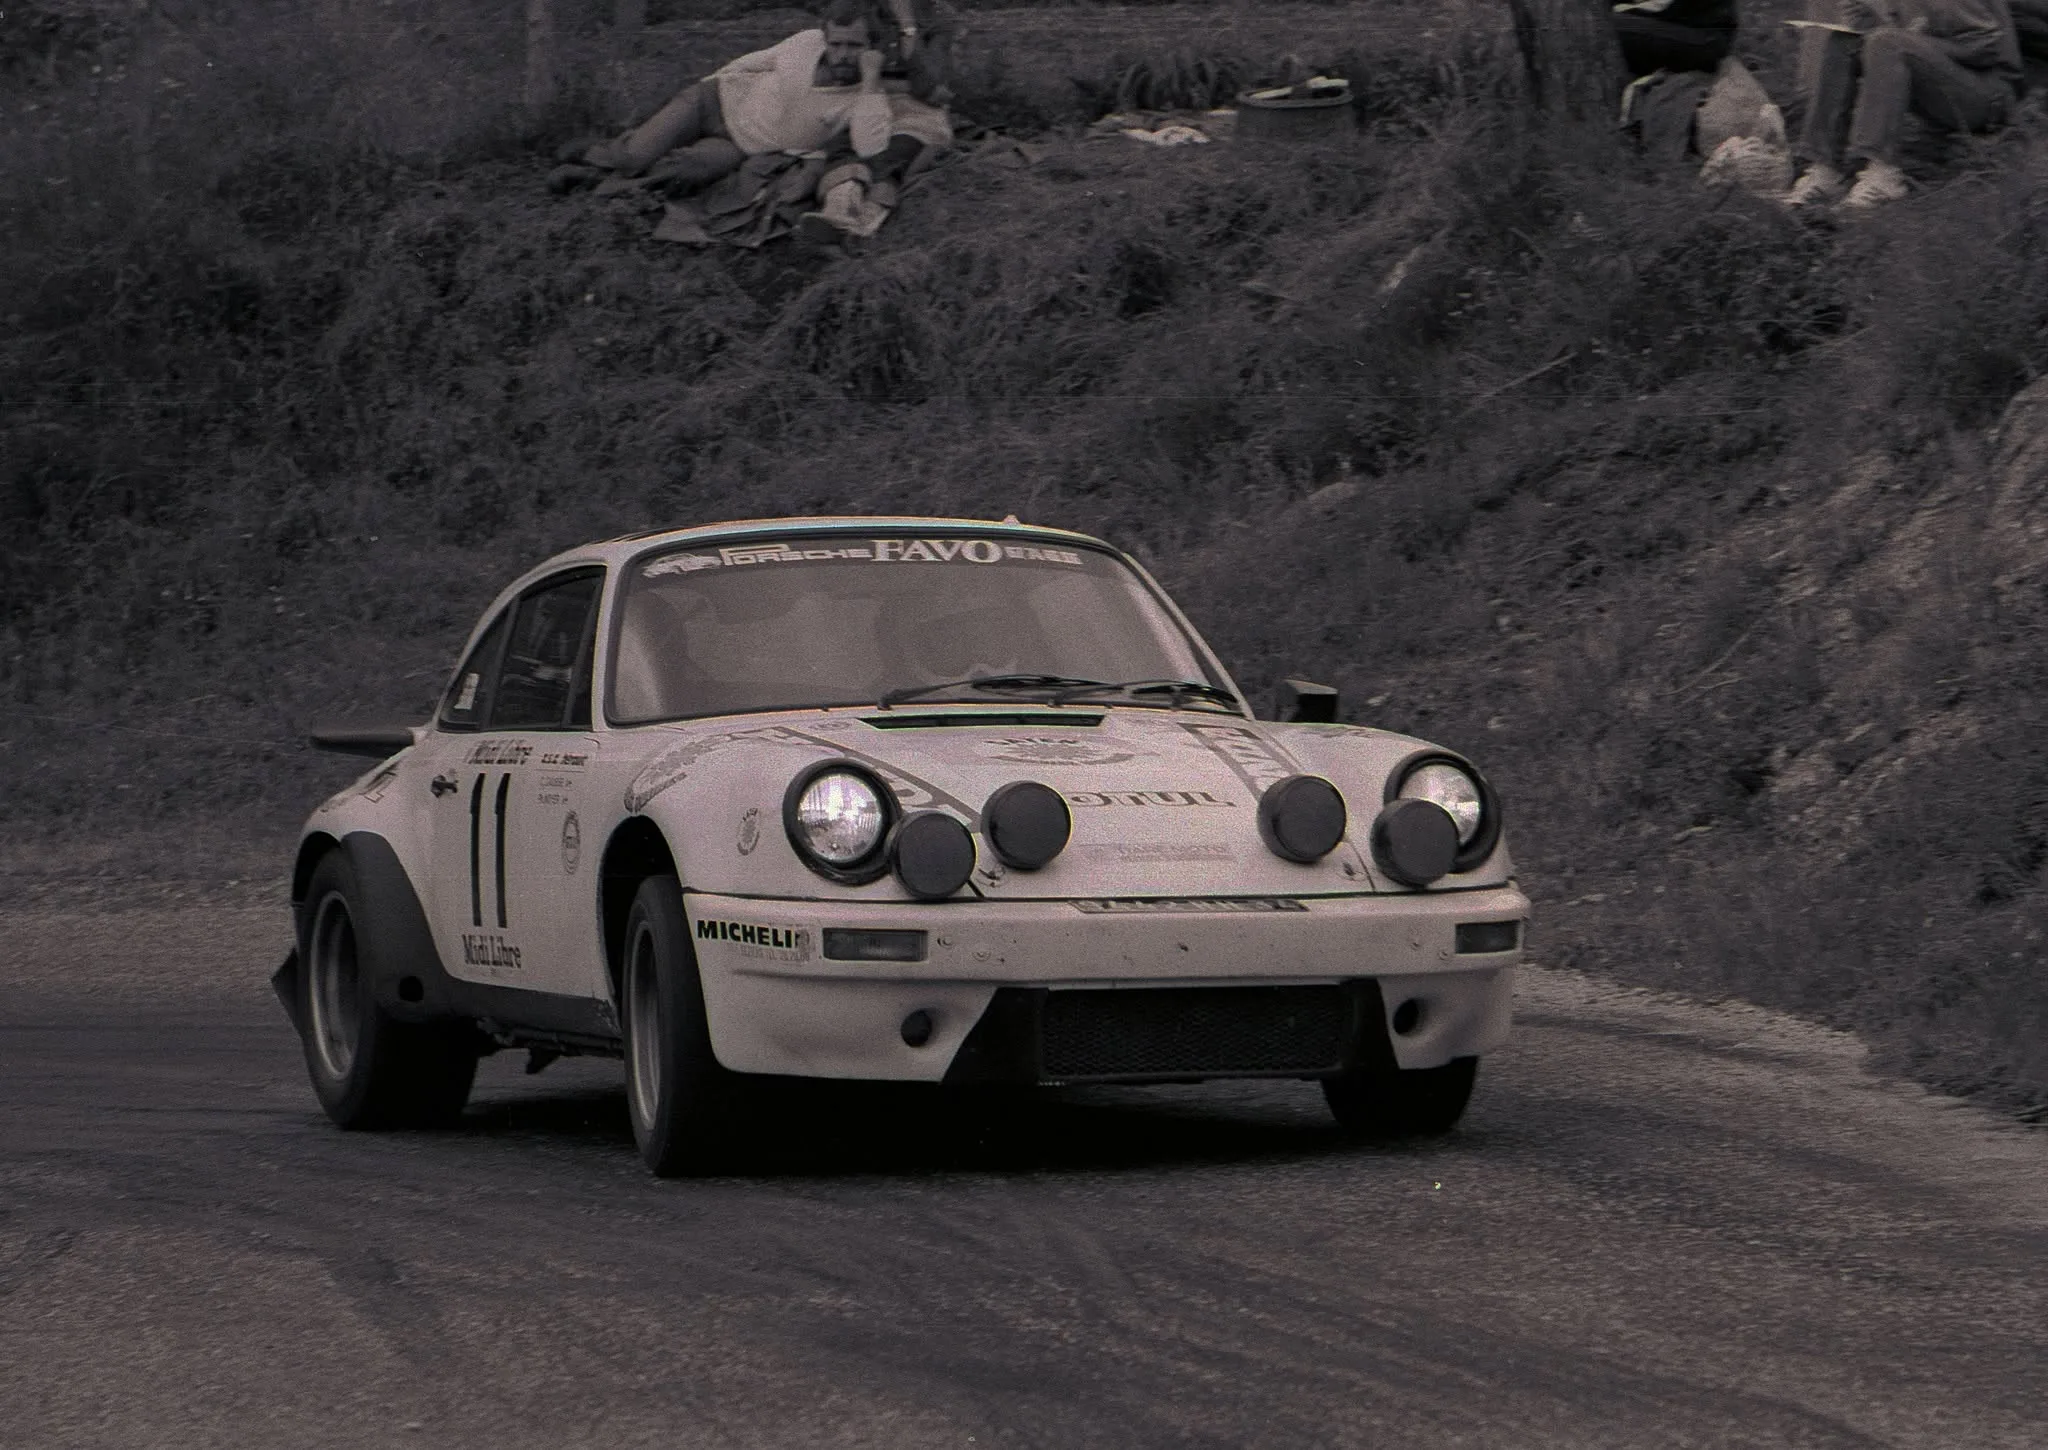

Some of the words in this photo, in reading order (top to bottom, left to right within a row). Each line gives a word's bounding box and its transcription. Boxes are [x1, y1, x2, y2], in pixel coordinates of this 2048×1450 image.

[871, 540, 1003, 563] FAVO
[1064, 791, 1236, 808] OTUL
[470, 772, 511, 929] 11
[462, 934, 491, 966] Midi
[489, 935, 522, 969] Libre
